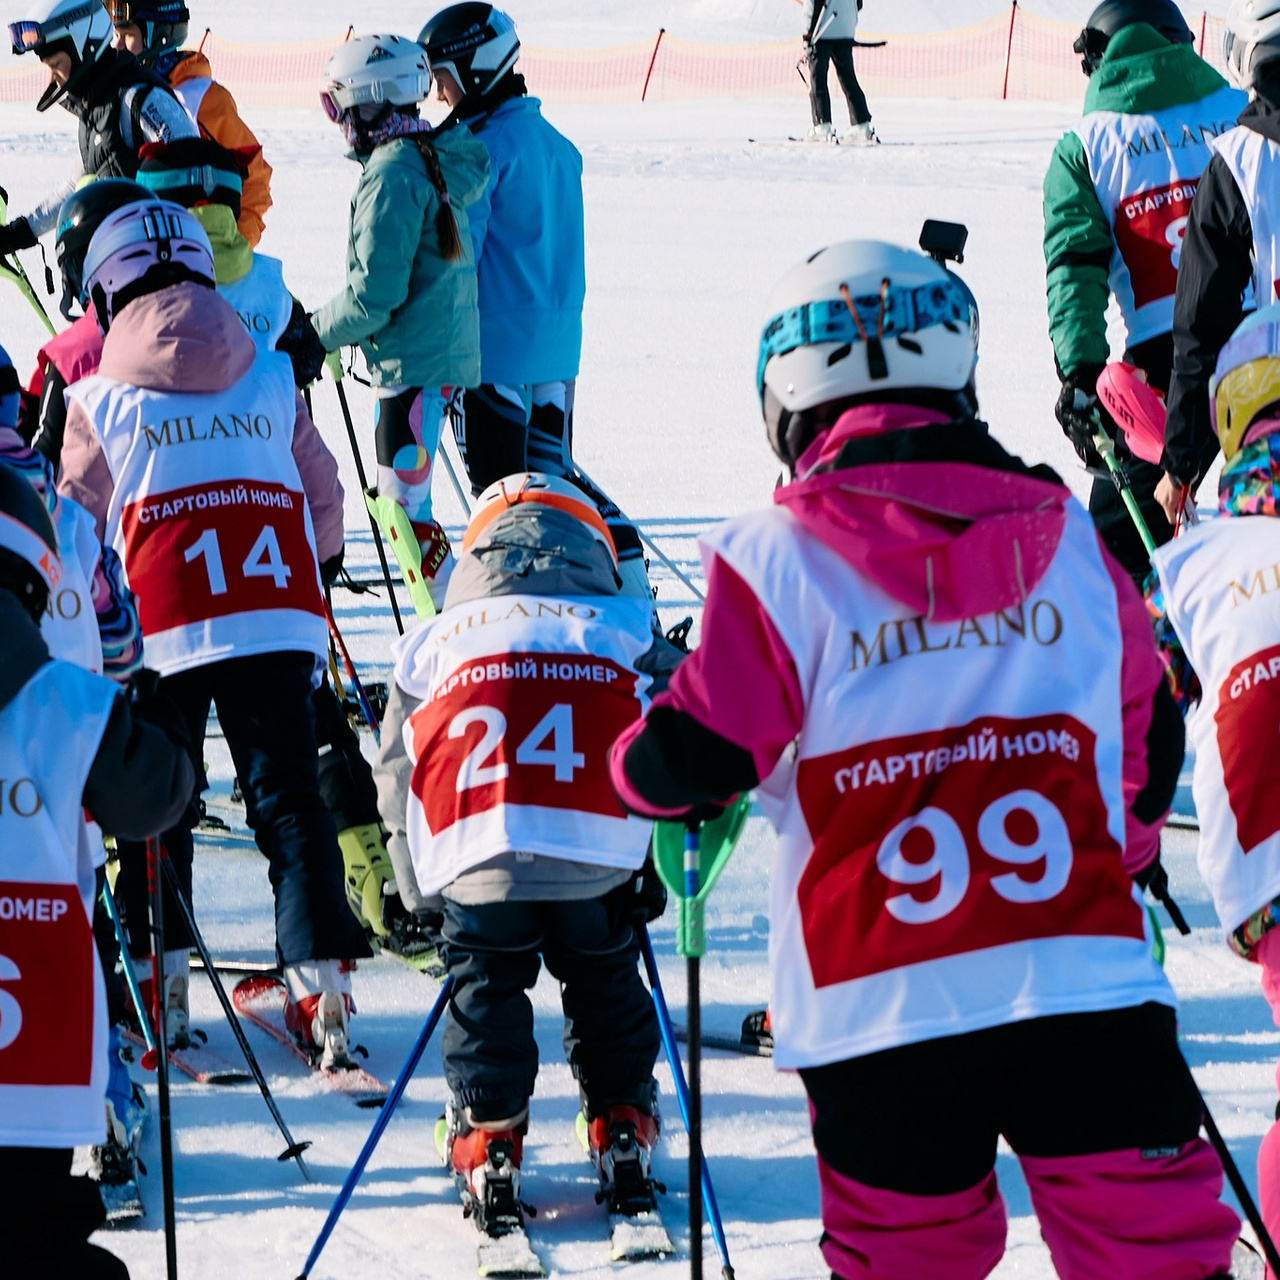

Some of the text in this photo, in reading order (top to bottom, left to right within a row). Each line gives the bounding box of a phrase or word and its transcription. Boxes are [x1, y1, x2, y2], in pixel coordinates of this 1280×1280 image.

[143, 412, 273, 452] MILANO
[138, 485, 248, 524] СТАРТОВЫЙ
[184, 524, 292, 595] 14
[435, 602, 597, 648] MILANO
[848, 599, 1064, 673] MILANO
[436, 658, 618, 700] АРТОВЫЙ НОМЕР
[447, 703, 585, 795] 24
[876, 788, 1074, 925] 99
